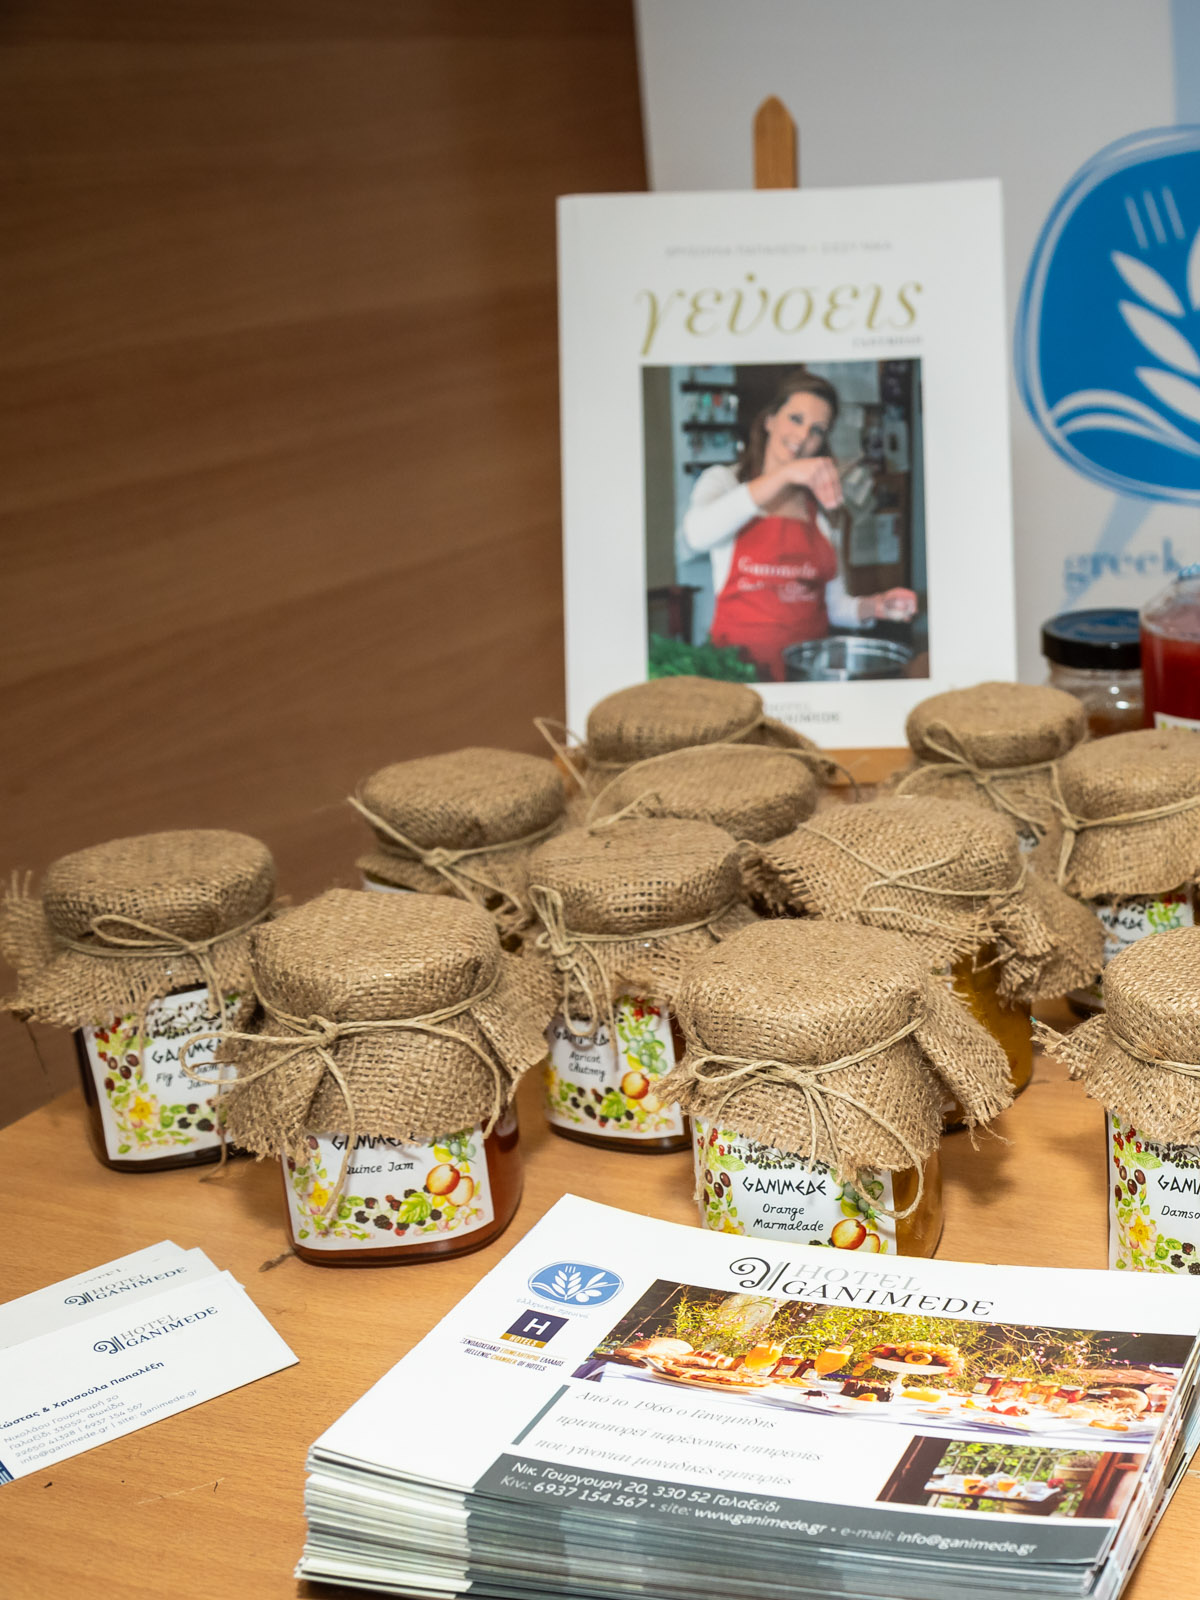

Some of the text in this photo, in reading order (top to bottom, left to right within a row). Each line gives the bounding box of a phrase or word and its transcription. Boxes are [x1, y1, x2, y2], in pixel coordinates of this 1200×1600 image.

[156, 1072, 173, 1087] Fig
[388, 1162, 414, 1173] Jam
[742, 1176, 827, 1196] GANIMEDE
[762, 1203, 805, 1221] Orange
[752, 1219, 824, 1232] Marmalade
[92, 1273, 150, 1295] HOTEL
[96, 1266, 188, 1300] GANIMEDE
[795, 1264, 922, 1292] HOTEL
[782, 1279, 994, 1316] GANIMEDE
[120, 1314, 179, 1340] HOTEL
[126, 1306, 219, 1347] GANIMEDE
[522, 1317, 551, 1335] H
[508, 1335, 538, 1347] HOTELS
[464, 1348, 491, 1359] HELLENIC
[525, 1362, 547, 1371] HOTELS
[52, 1384, 109, 1409] Χρυσούλα
[110, 1361, 165, 1386] Παπαλέξη
[634, 1401, 673, 1414] 1966
[512, 1462, 538, 1477] Νικ.
[541, 1467, 622, 1491] Γουργουρή
[624, 1481, 649, 1496] 20,
[653, 1485, 686, 1500] 330
[687, 1490, 712, 1504] 52
[533, 1482, 577, 1498] 6937
[578, 1490, 612, 1504] 154
[612, 1495, 648, 1509] 567
[658, 1501, 692, 1516] site:
[694, 1508, 828, 1536] www.ganimede.gr
[840, 1525, 894, 1542] e-mail:
[896, 1531, 1038, 1557] info@ganimede.gr
